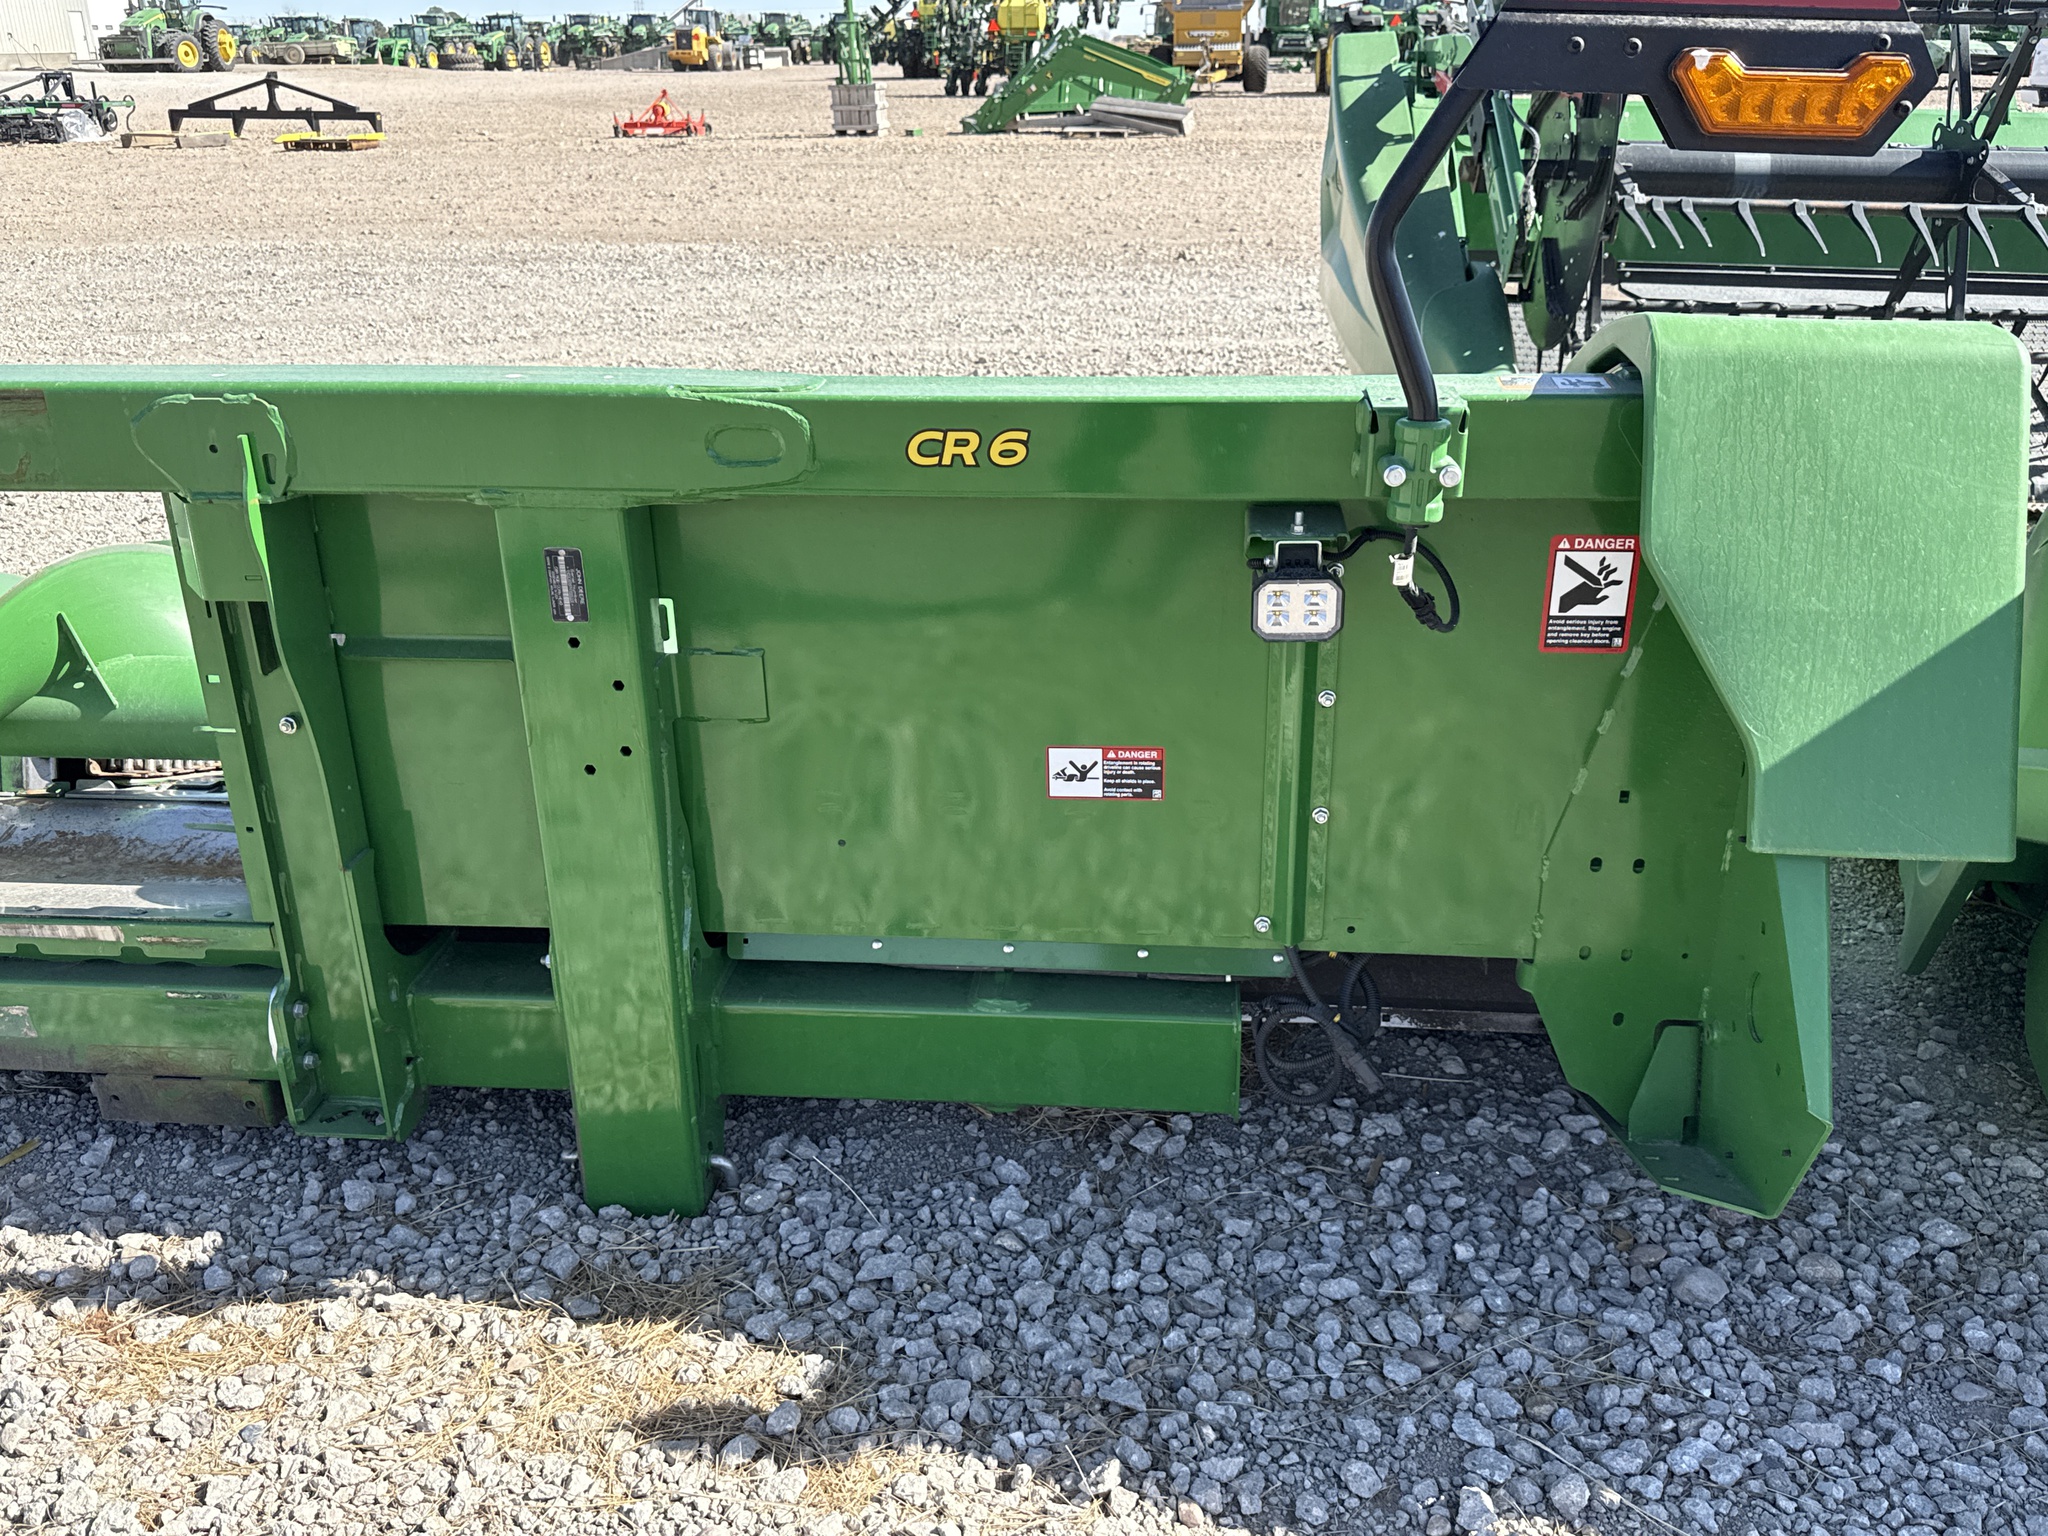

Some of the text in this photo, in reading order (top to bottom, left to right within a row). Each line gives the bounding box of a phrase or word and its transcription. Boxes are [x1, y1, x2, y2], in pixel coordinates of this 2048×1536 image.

[905, 428, 1031, 467] CR 6
[1574, 538, 1635, 549] DANGER
